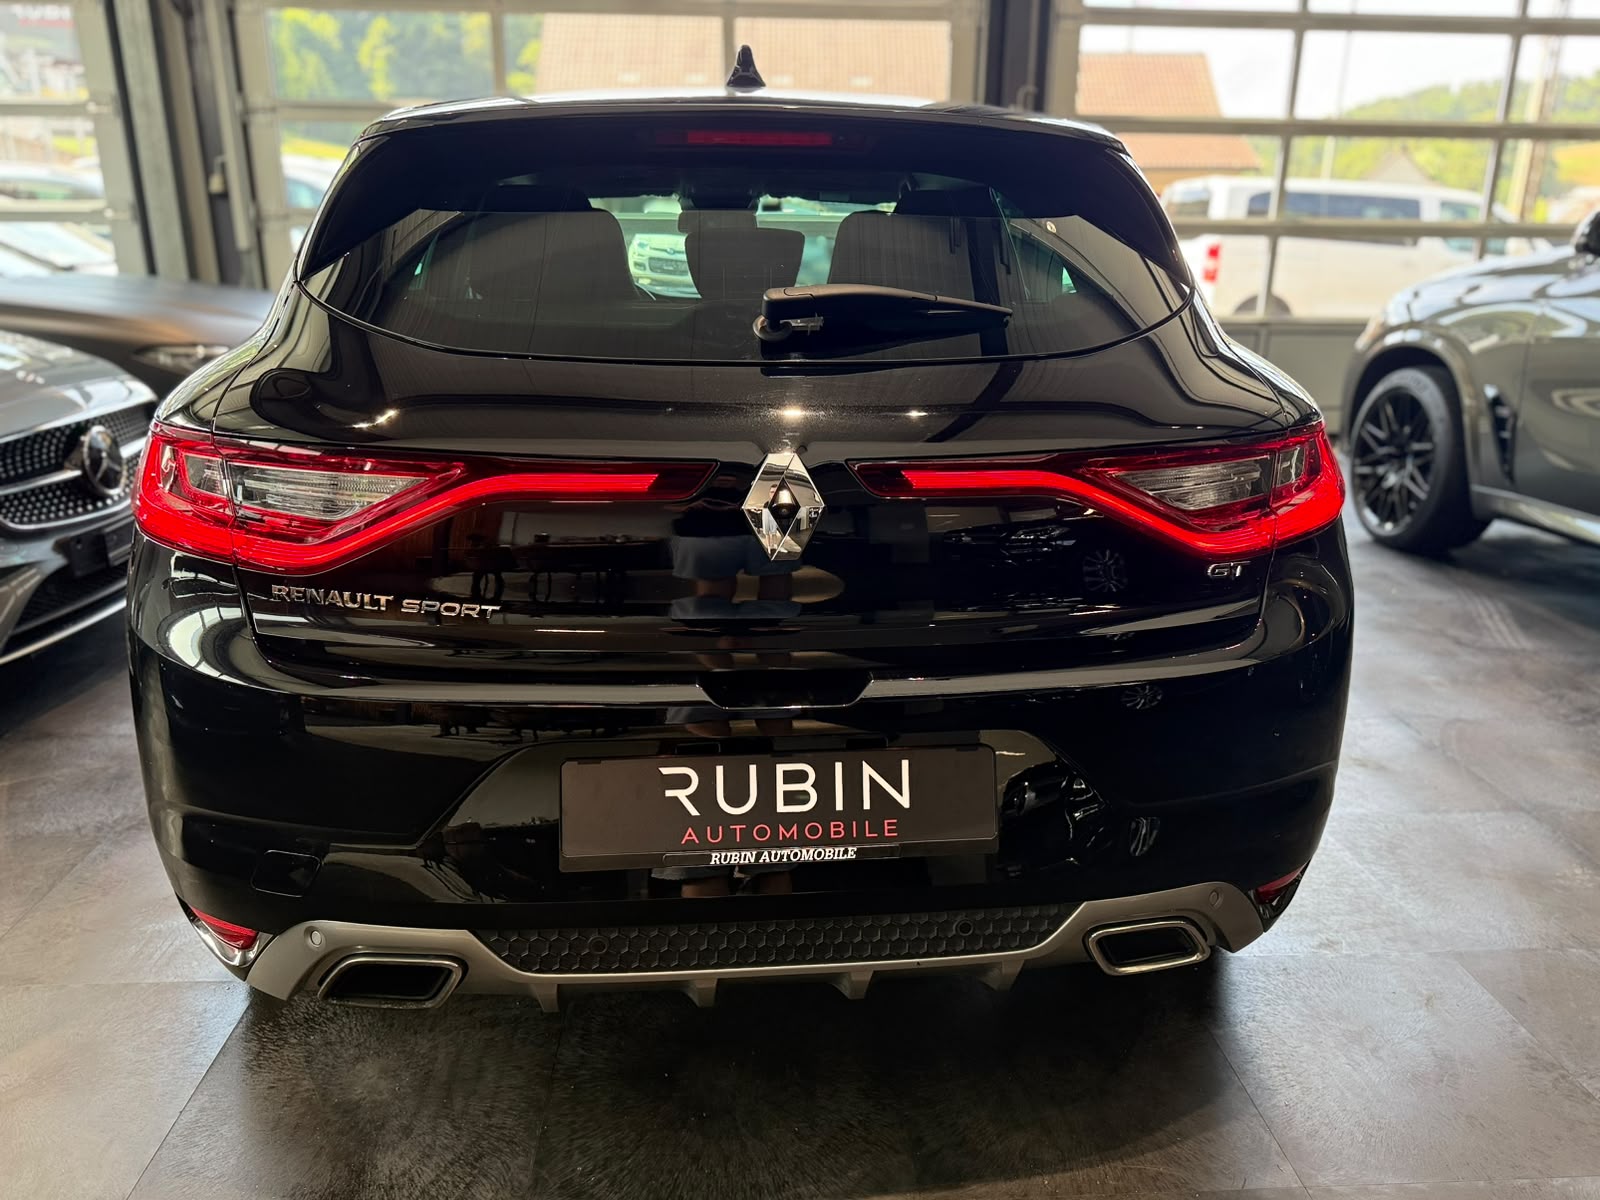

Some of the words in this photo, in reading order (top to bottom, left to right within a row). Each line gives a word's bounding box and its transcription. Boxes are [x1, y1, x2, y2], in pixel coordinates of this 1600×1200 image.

[1207, 560, 1251, 577] GT
[272, 584, 394, 611] RENAULT
[400, 598, 501, 618] SPORT
[658, 759, 910, 816] RUBIN
[681, 819, 898, 845] AUTOMOBILE
[710, 850, 755, 865] RUBIN
[758, 847, 857, 863] AUTOMOBILE
